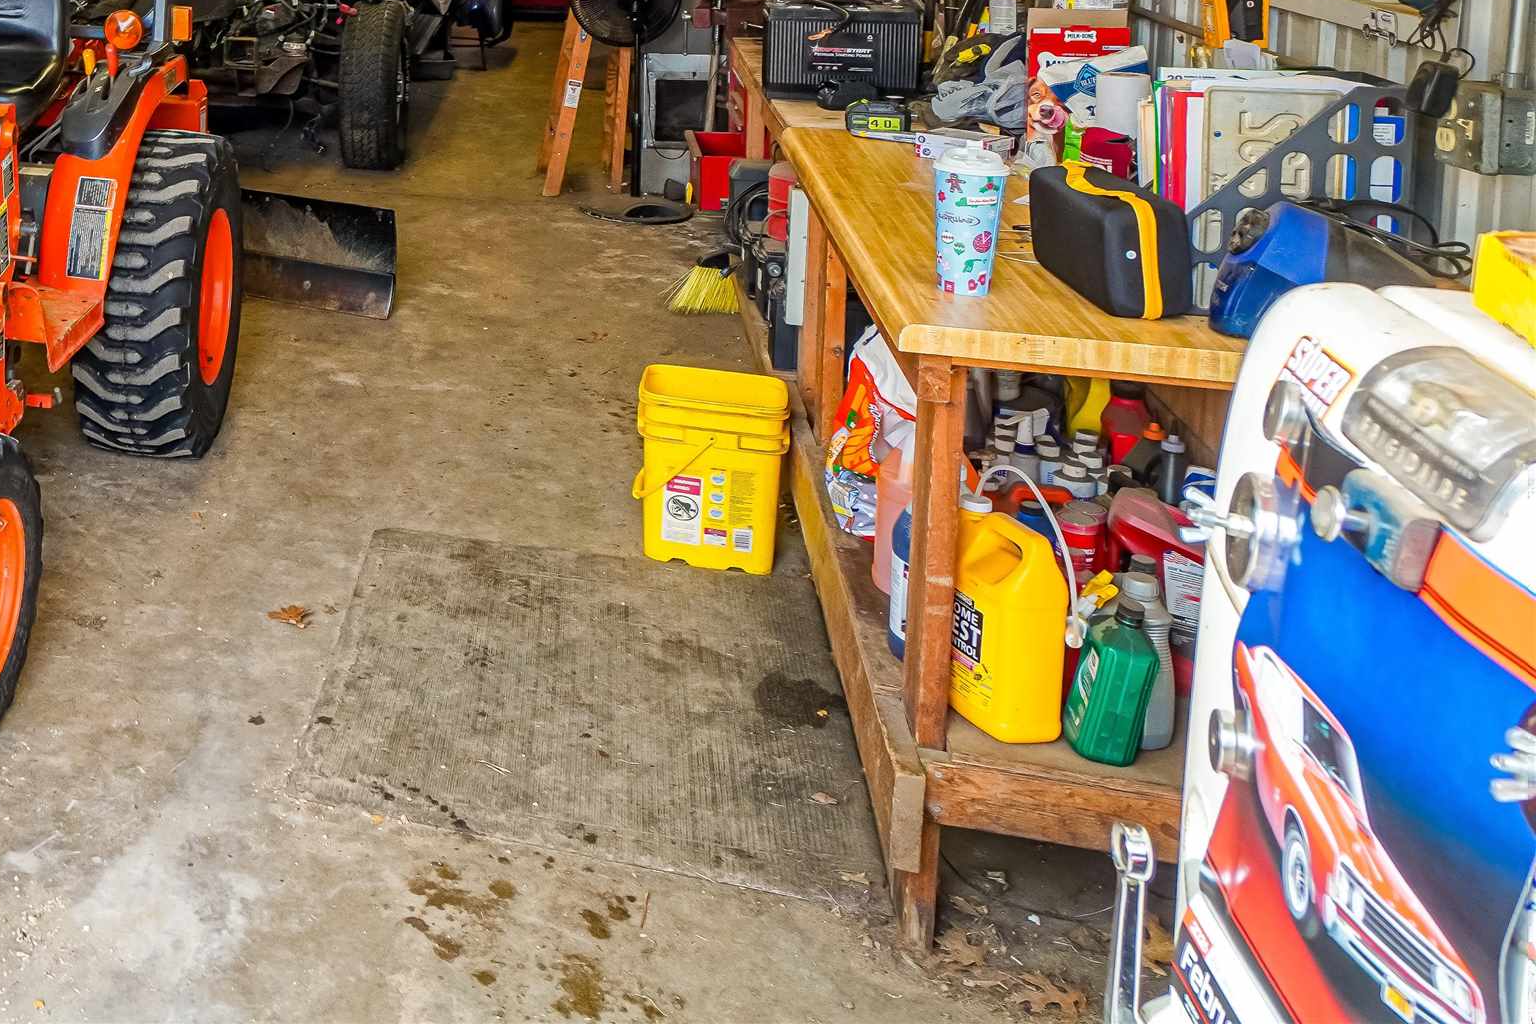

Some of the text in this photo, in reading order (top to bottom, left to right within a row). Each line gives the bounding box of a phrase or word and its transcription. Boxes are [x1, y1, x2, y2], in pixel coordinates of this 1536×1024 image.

[1067, 32, 1095, 40] MILK-BONE
[954, 602, 979, 627] OME
[951, 616, 982, 648] EST
[953, 638, 979, 661] TROL
[1180, 941, 1235, 1024] Febr
